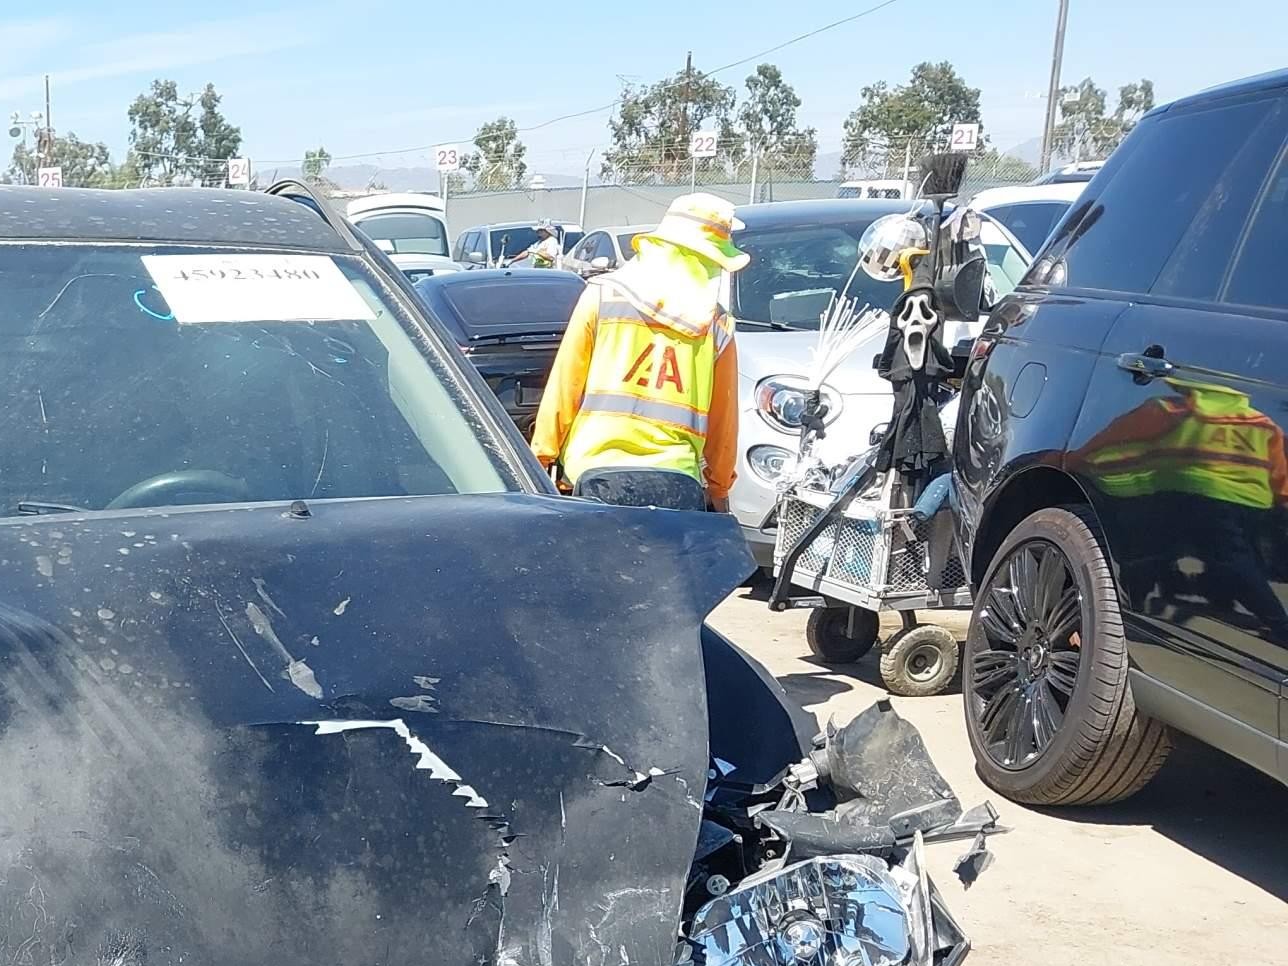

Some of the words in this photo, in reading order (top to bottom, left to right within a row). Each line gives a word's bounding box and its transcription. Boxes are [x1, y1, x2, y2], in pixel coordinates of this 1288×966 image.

[953, 129, 975, 144] 21
[694, 137, 714, 152] 22
[438, 150, 457, 165] 23
[41, 172, 60, 187] 25
